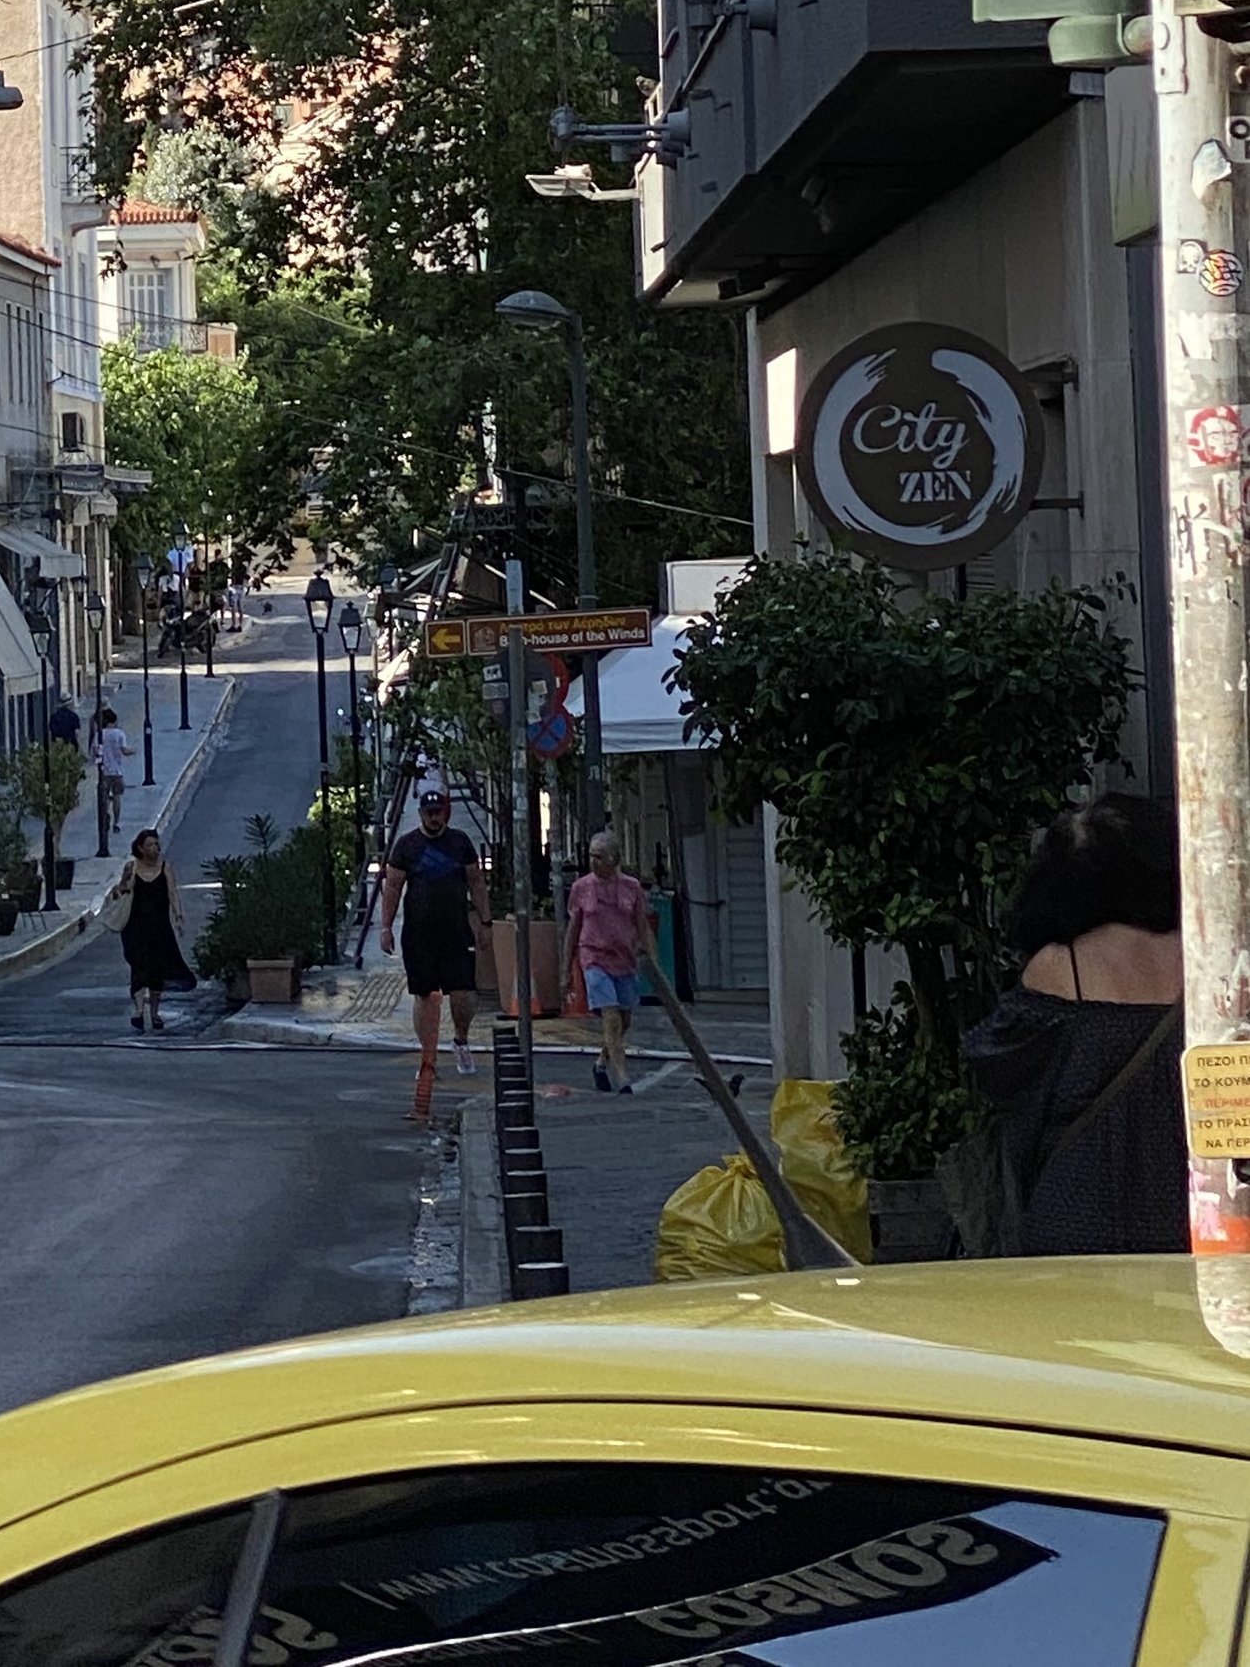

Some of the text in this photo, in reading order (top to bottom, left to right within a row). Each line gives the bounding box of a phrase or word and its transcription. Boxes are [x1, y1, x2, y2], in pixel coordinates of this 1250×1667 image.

[853, 403, 970, 469] City
[900, 470, 971, 503] ZEN
[572, 631, 584, 643] of
[586, 629, 606, 641] the
[608, 626, 645, 640] Winds
[1197, 1056, 1235, 1067] ΠΕΖΟΙ
[1193, 1078, 1210, 1088] ΤΟ
[1198, 1119, 1212, 1129] ΤΟ
[1206, 1138, 1222, 1148] ΝΑ
